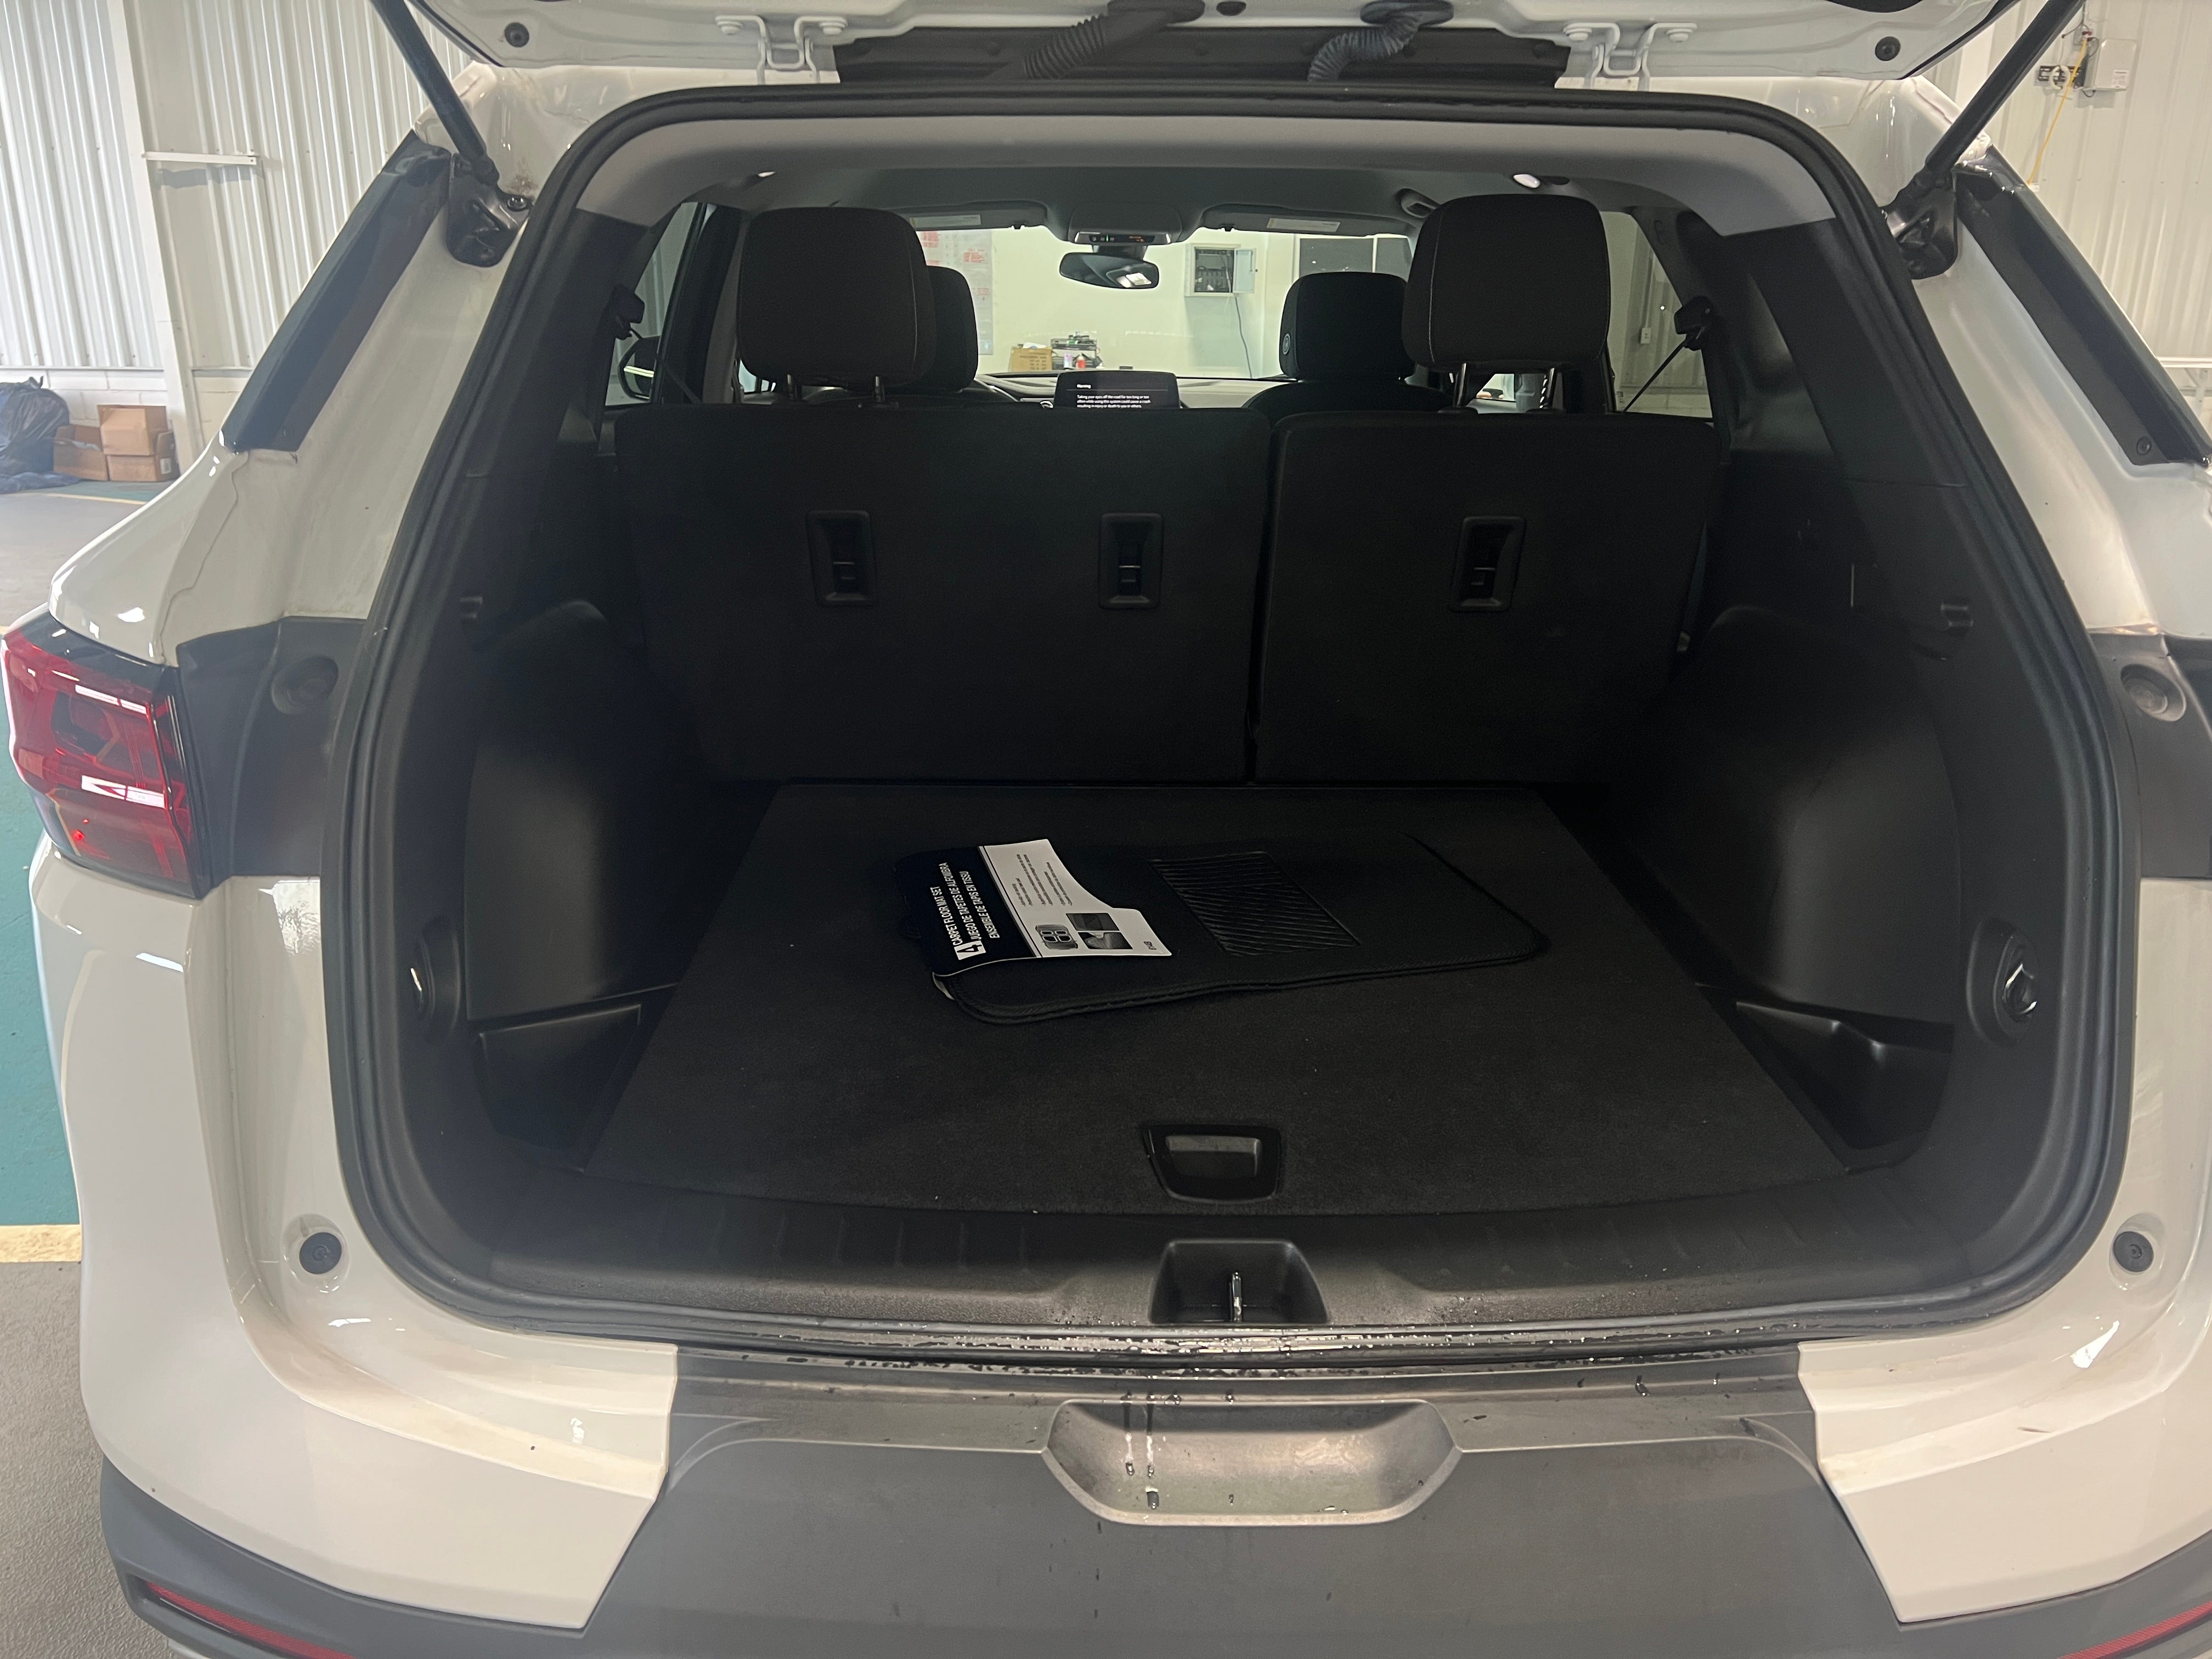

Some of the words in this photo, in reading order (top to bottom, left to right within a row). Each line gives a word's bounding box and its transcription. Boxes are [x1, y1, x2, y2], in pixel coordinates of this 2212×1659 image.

[939, 862, 957, 887] ALFOMBRA
[959, 871, 973, 884] TISSU
[930, 887, 942, 896] SET
[969, 891, 983, 905] TAPIS
[934, 896, 947, 906] MAT
[952, 894, 969, 915] TAPETES
[939, 905, 954, 924] FLOOR
[965, 923, 982, 940] JUEGO
[979, 912, 1000, 938] ENSEMBLE
[946, 923, 963, 946] CARPET
[957, 944, 982, 953] 4
